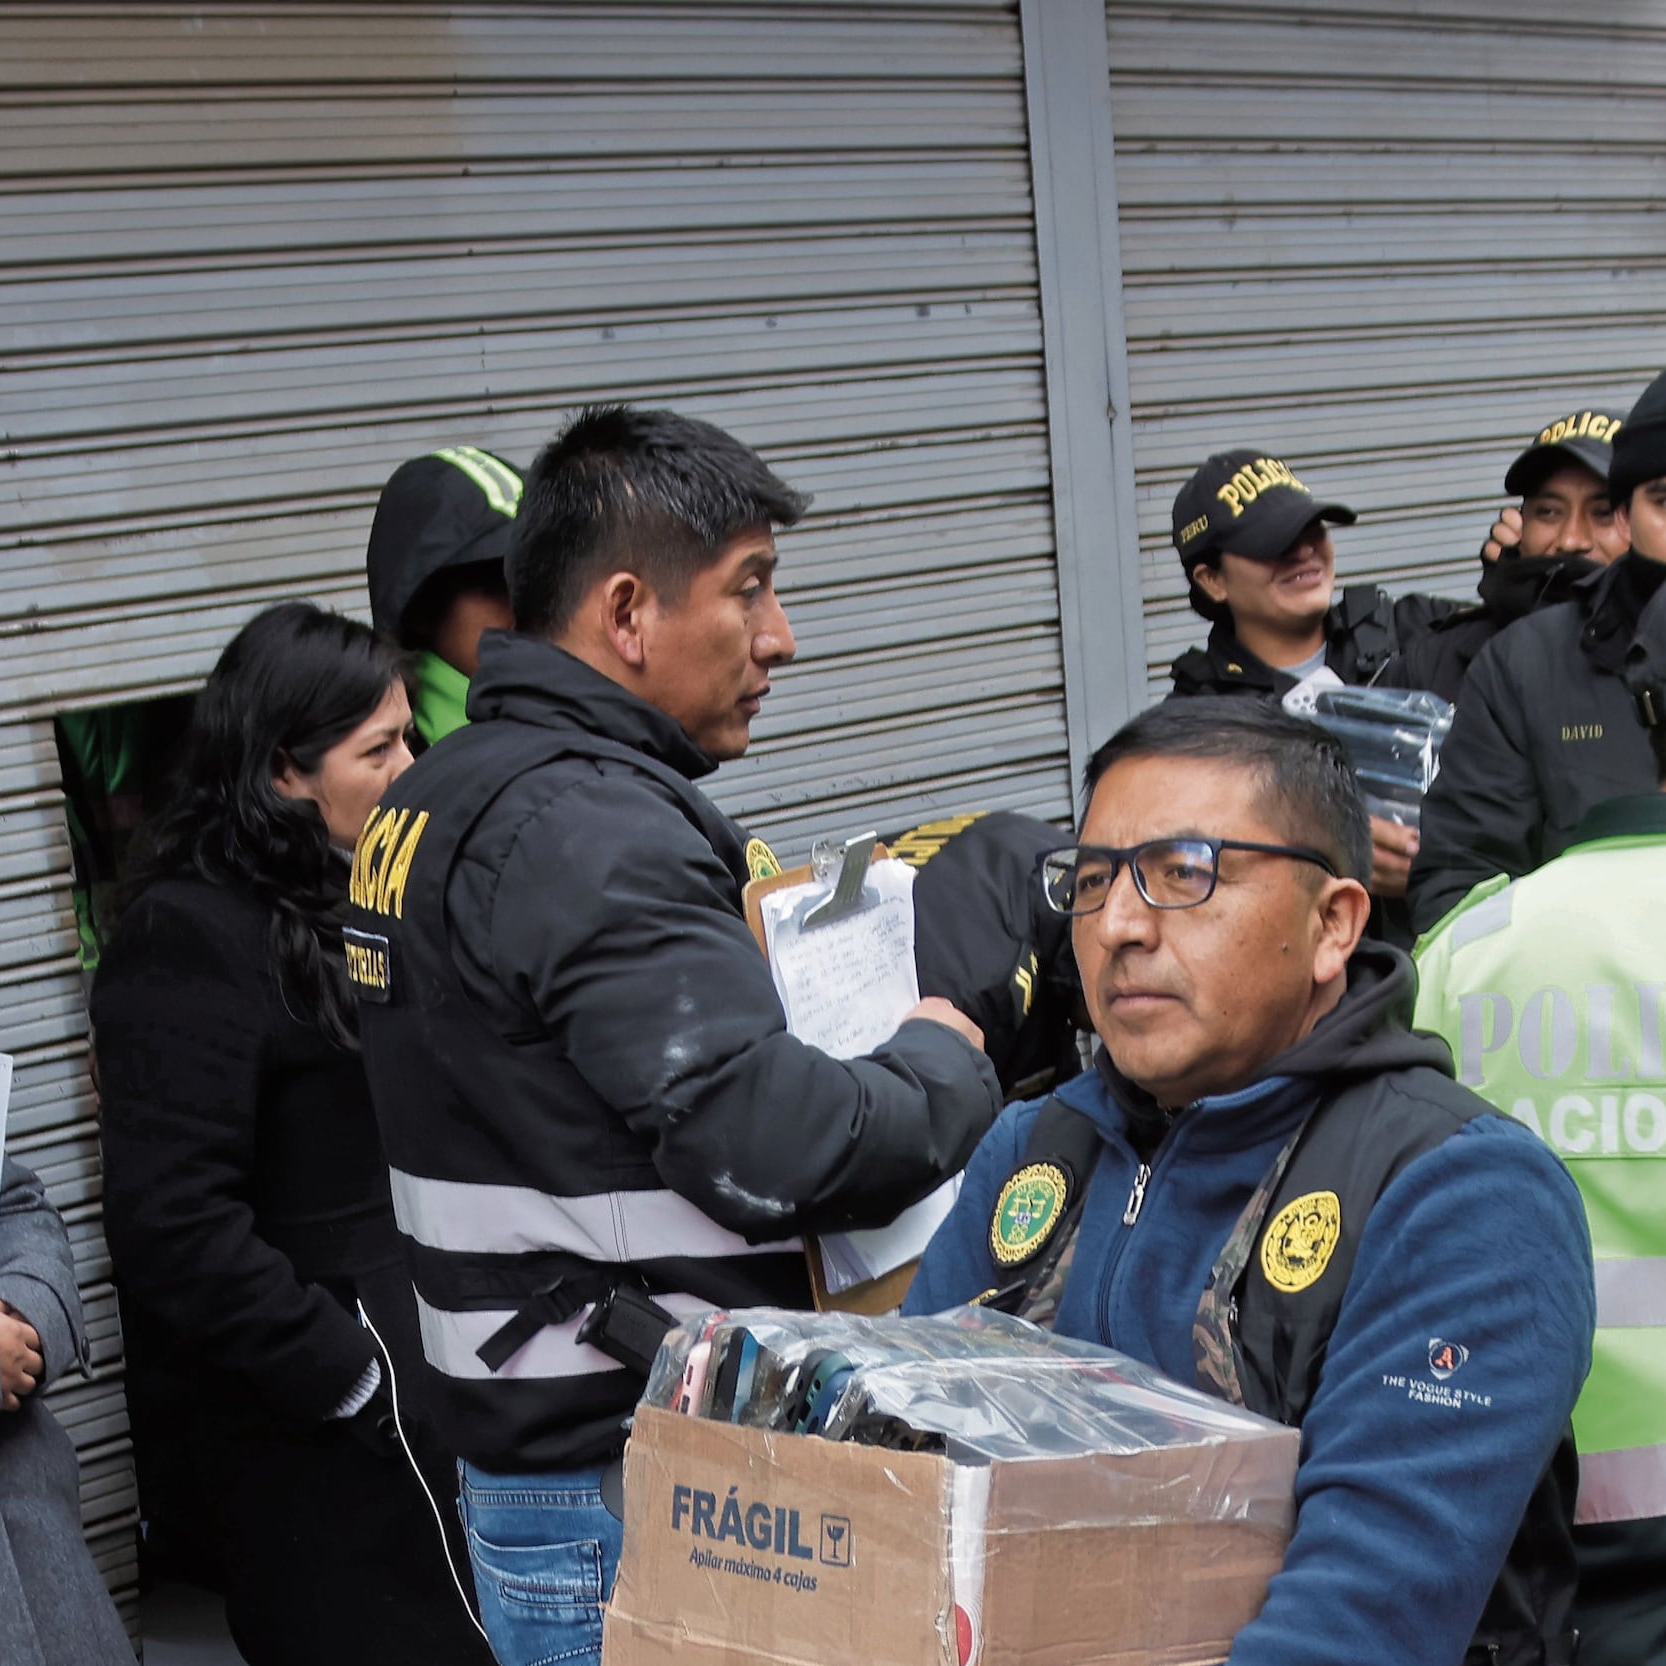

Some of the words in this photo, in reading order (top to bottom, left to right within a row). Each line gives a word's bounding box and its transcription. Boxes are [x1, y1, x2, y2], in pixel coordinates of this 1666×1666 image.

[1539, 411, 1622, 444] POLICI
[1562, 724, 1603, 740] DAVID
[1382, 1374, 1406, 1388] THE
[1409, 1378, 1451, 1396] VOGUE
[1453, 1388, 1492, 1408] STYLE
[1408, 1389, 1461, 1409] FASHION
[671, 1484, 813, 1560] FRÁGIL
[689, 1546, 723, 1570] Apilar
[724, 1557, 771, 1582] máximo
[772, 1567, 782, 1585] 4
[783, 1570, 817, 1593] cajas
